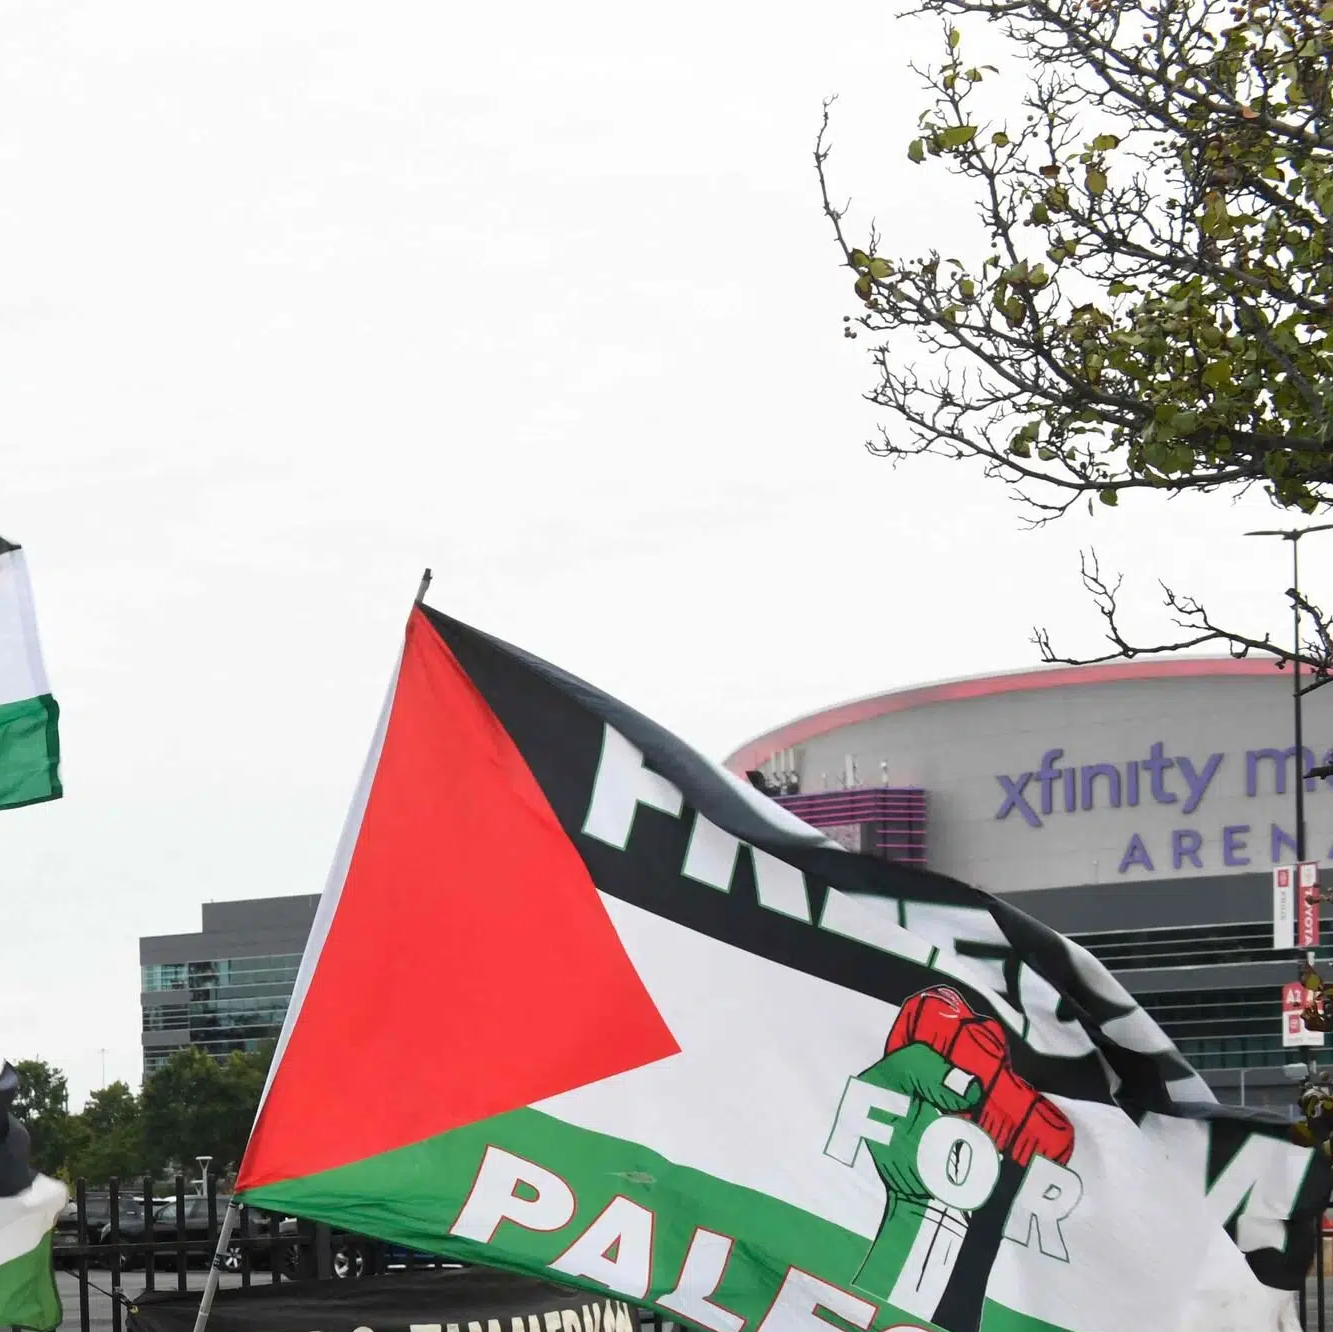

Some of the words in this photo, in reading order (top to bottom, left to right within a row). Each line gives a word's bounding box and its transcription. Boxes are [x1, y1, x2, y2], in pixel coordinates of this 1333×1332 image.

[994, 740, 1225, 829] xfinity
[1246, 743, 1333, 798] m
[1118, 821, 1333, 875] AREN
[824, 1073, 1084, 1263] FOR
